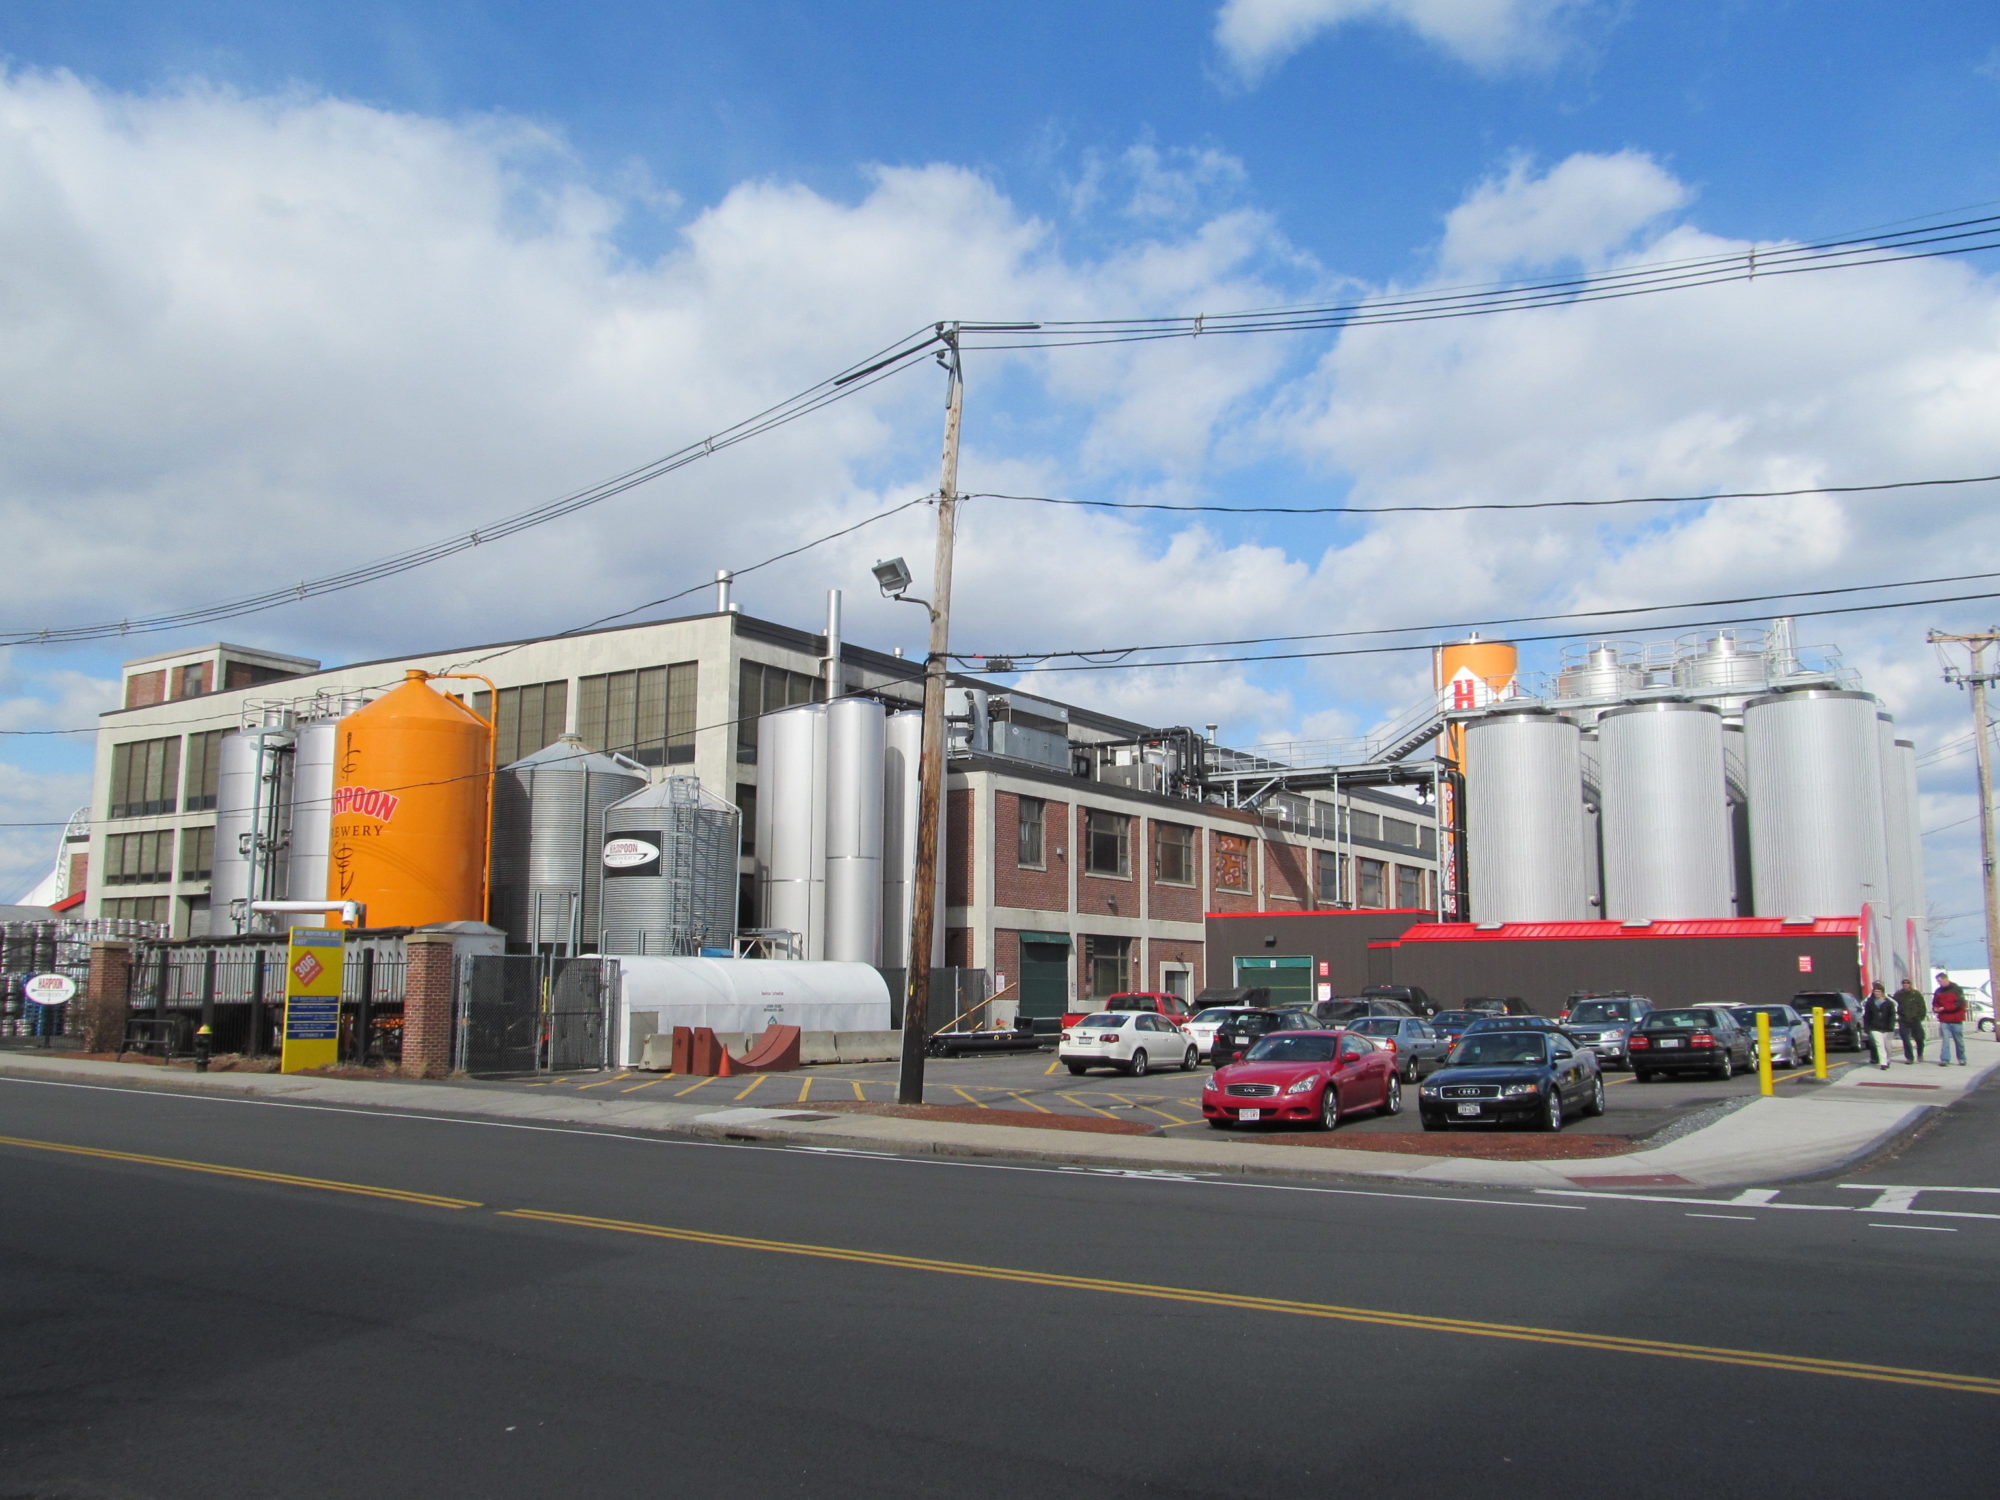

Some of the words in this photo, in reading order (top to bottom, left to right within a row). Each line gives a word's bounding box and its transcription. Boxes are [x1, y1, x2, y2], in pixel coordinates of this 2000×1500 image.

[332, 786, 399, 823] RPOON
[331, 825, 383, 838] EWERY
[295, 954, 316, 978] 306
